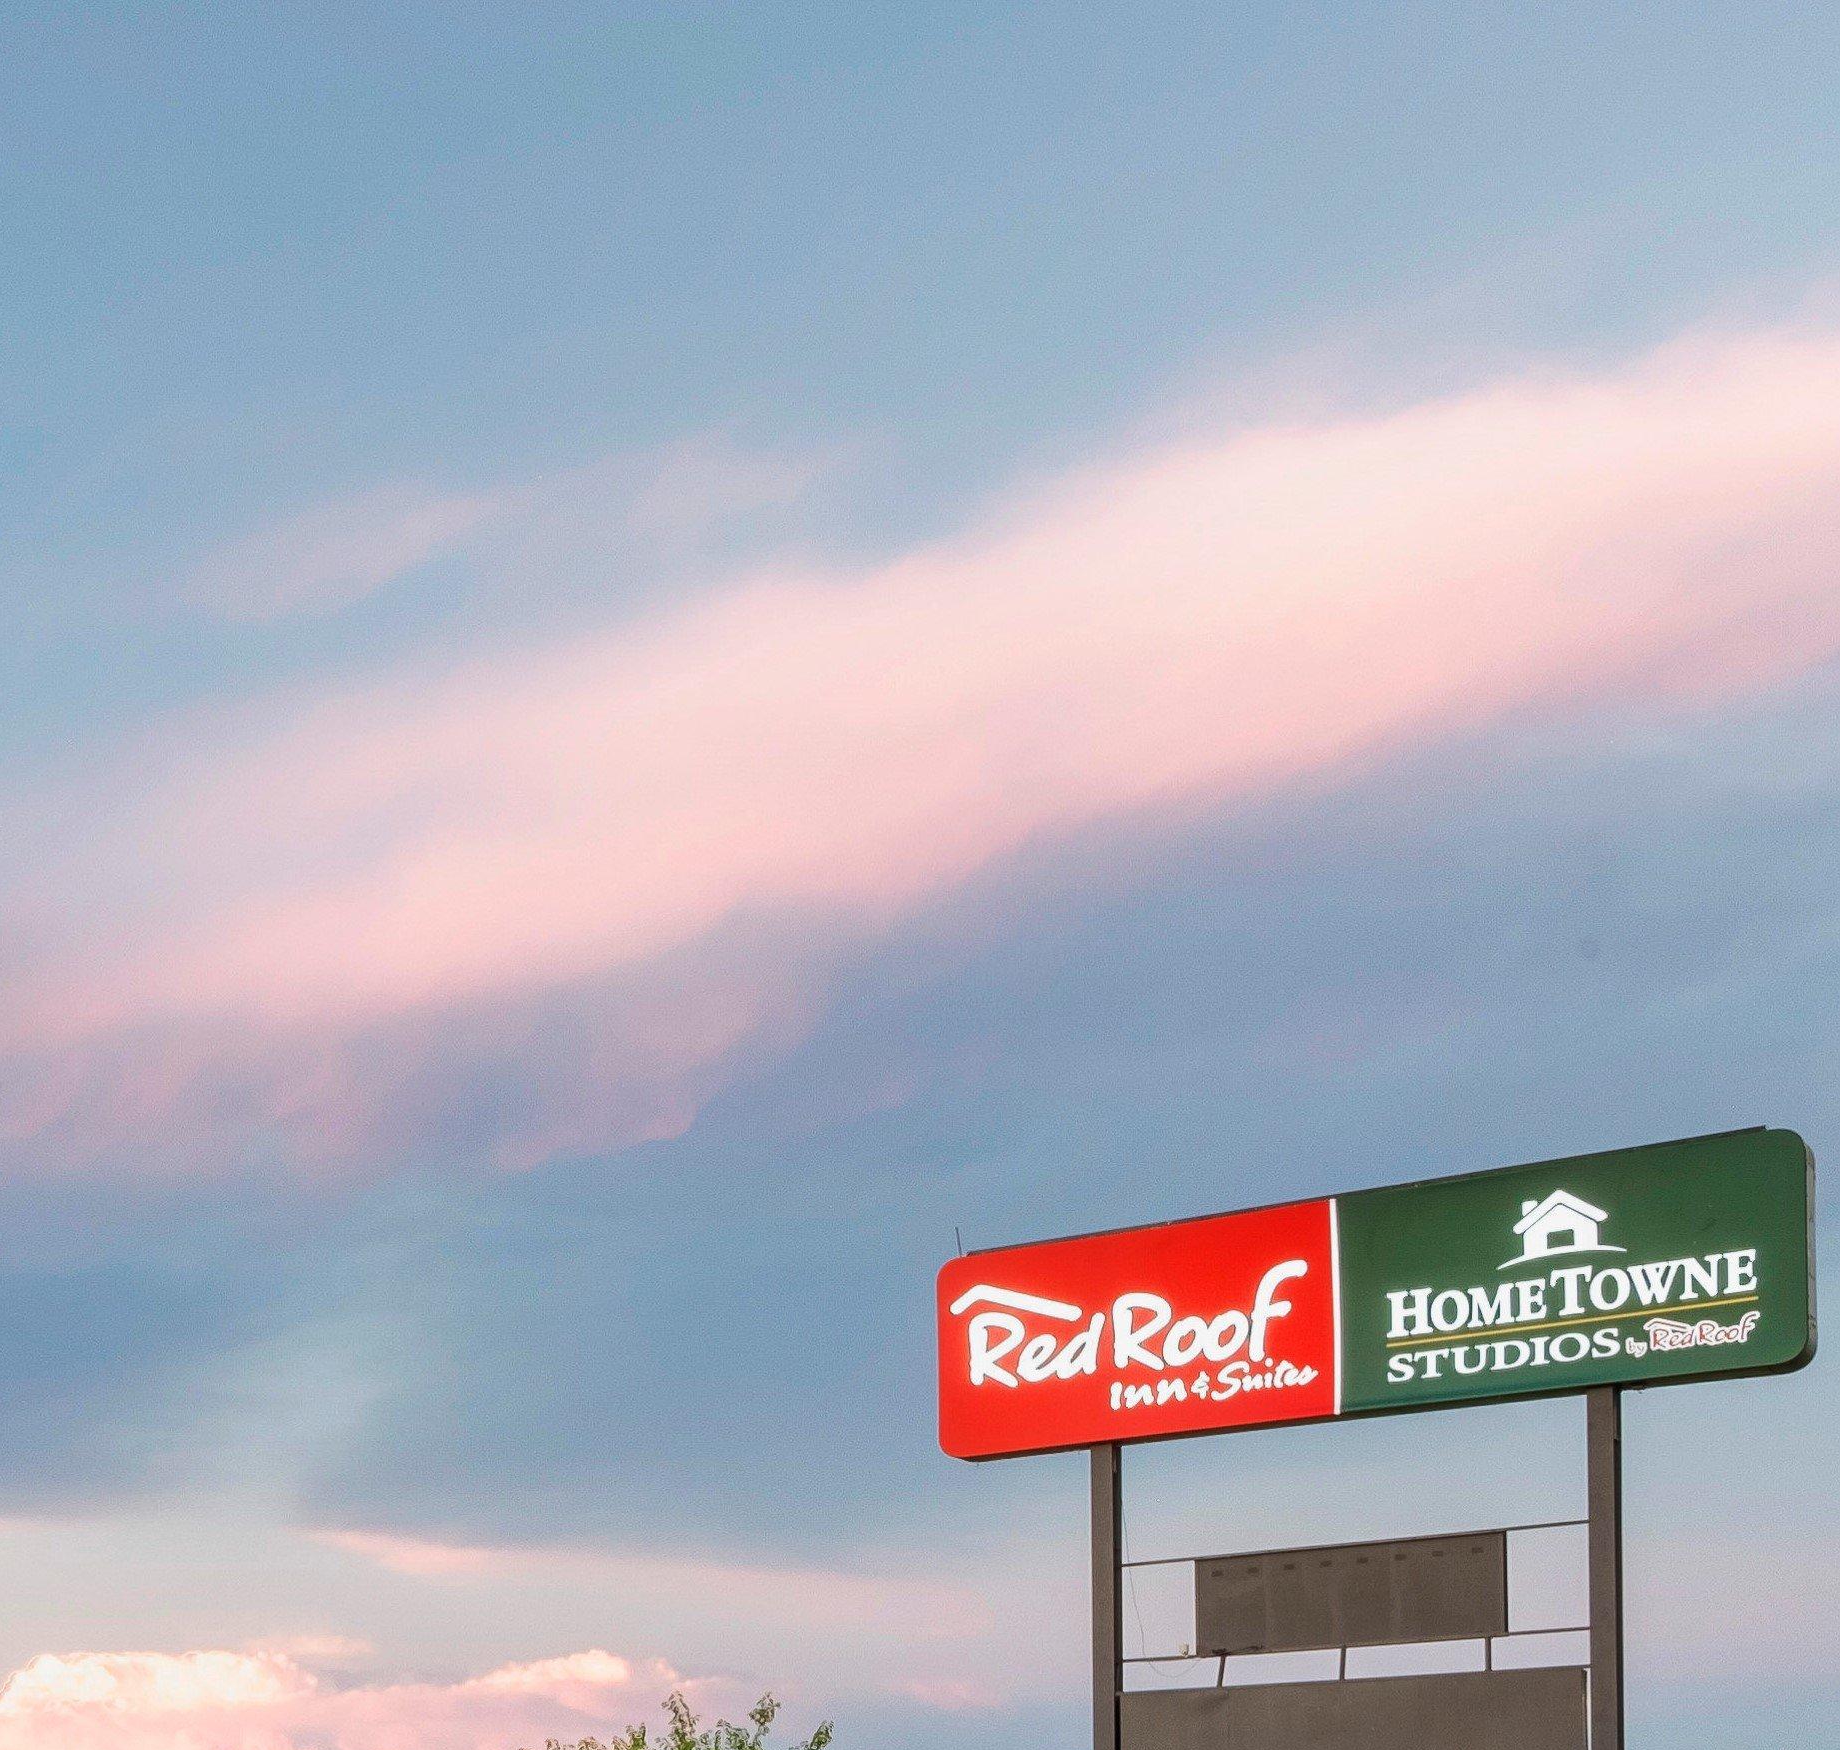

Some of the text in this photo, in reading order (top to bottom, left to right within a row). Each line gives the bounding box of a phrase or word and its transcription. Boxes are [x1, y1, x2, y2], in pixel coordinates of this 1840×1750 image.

[968, 1259, 1308, 1388] Red Roof
[1386, 1327, 1621, 1383] STUDIOS
[1625, 1337, 1648, 1358] by
[1694, 1311, 1761, 1346] Roof
[1110, 1357, 1319, 1411] Inn & Suites
